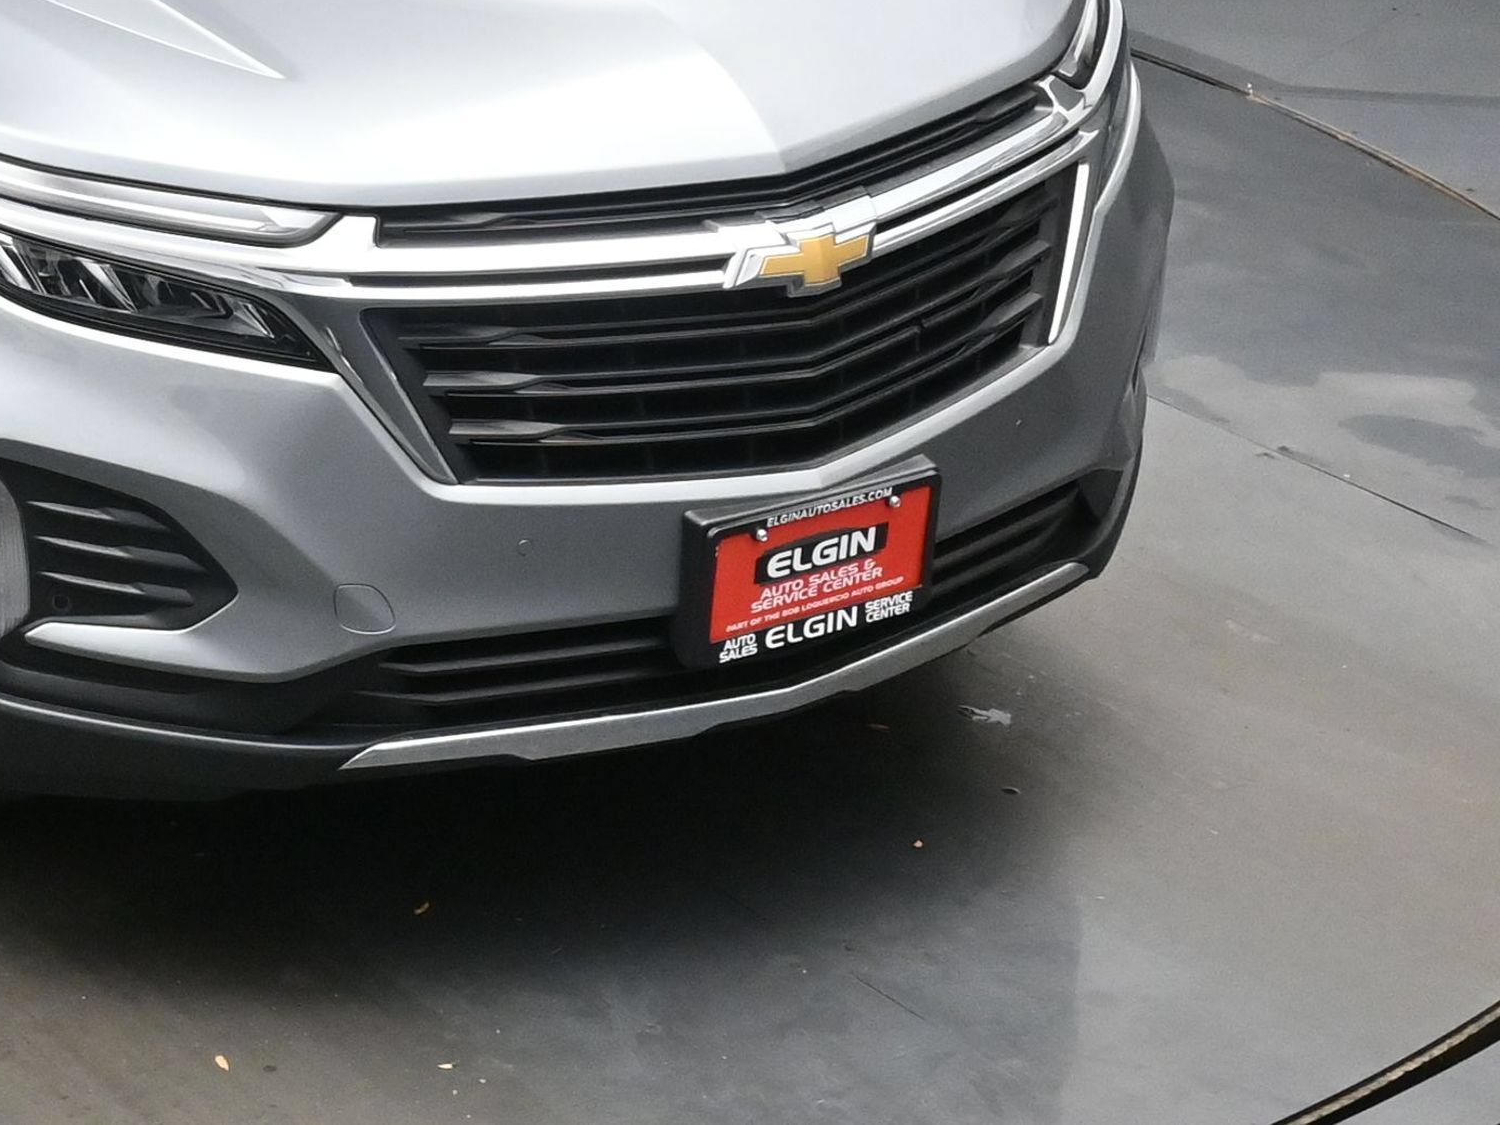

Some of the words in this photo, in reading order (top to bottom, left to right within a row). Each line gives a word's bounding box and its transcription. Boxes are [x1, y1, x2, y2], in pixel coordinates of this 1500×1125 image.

[767, 487, 892, 527] ELGINAUTOSALES.COM
[767, 526, 876, 578] ELGIN
[750, 585, 818, 614] SERVICE
[823, 566, 883, 593] CENTER
[760, 579, 804, 601] AUTO
[808, 563, 859, 587] SALES
[863, 558, 876, 571] &
[749, 616, 762, 626] OF
[850, 585, 874, 597] AUTO
[864, 590, 913, 614] SERVICE
[866, 602, 911, 623] CENTER
[723, 633, 756, 651] AUTO
[765, 606, 858, 649] ELGIN
[719, 643, 758, 664] SALES
